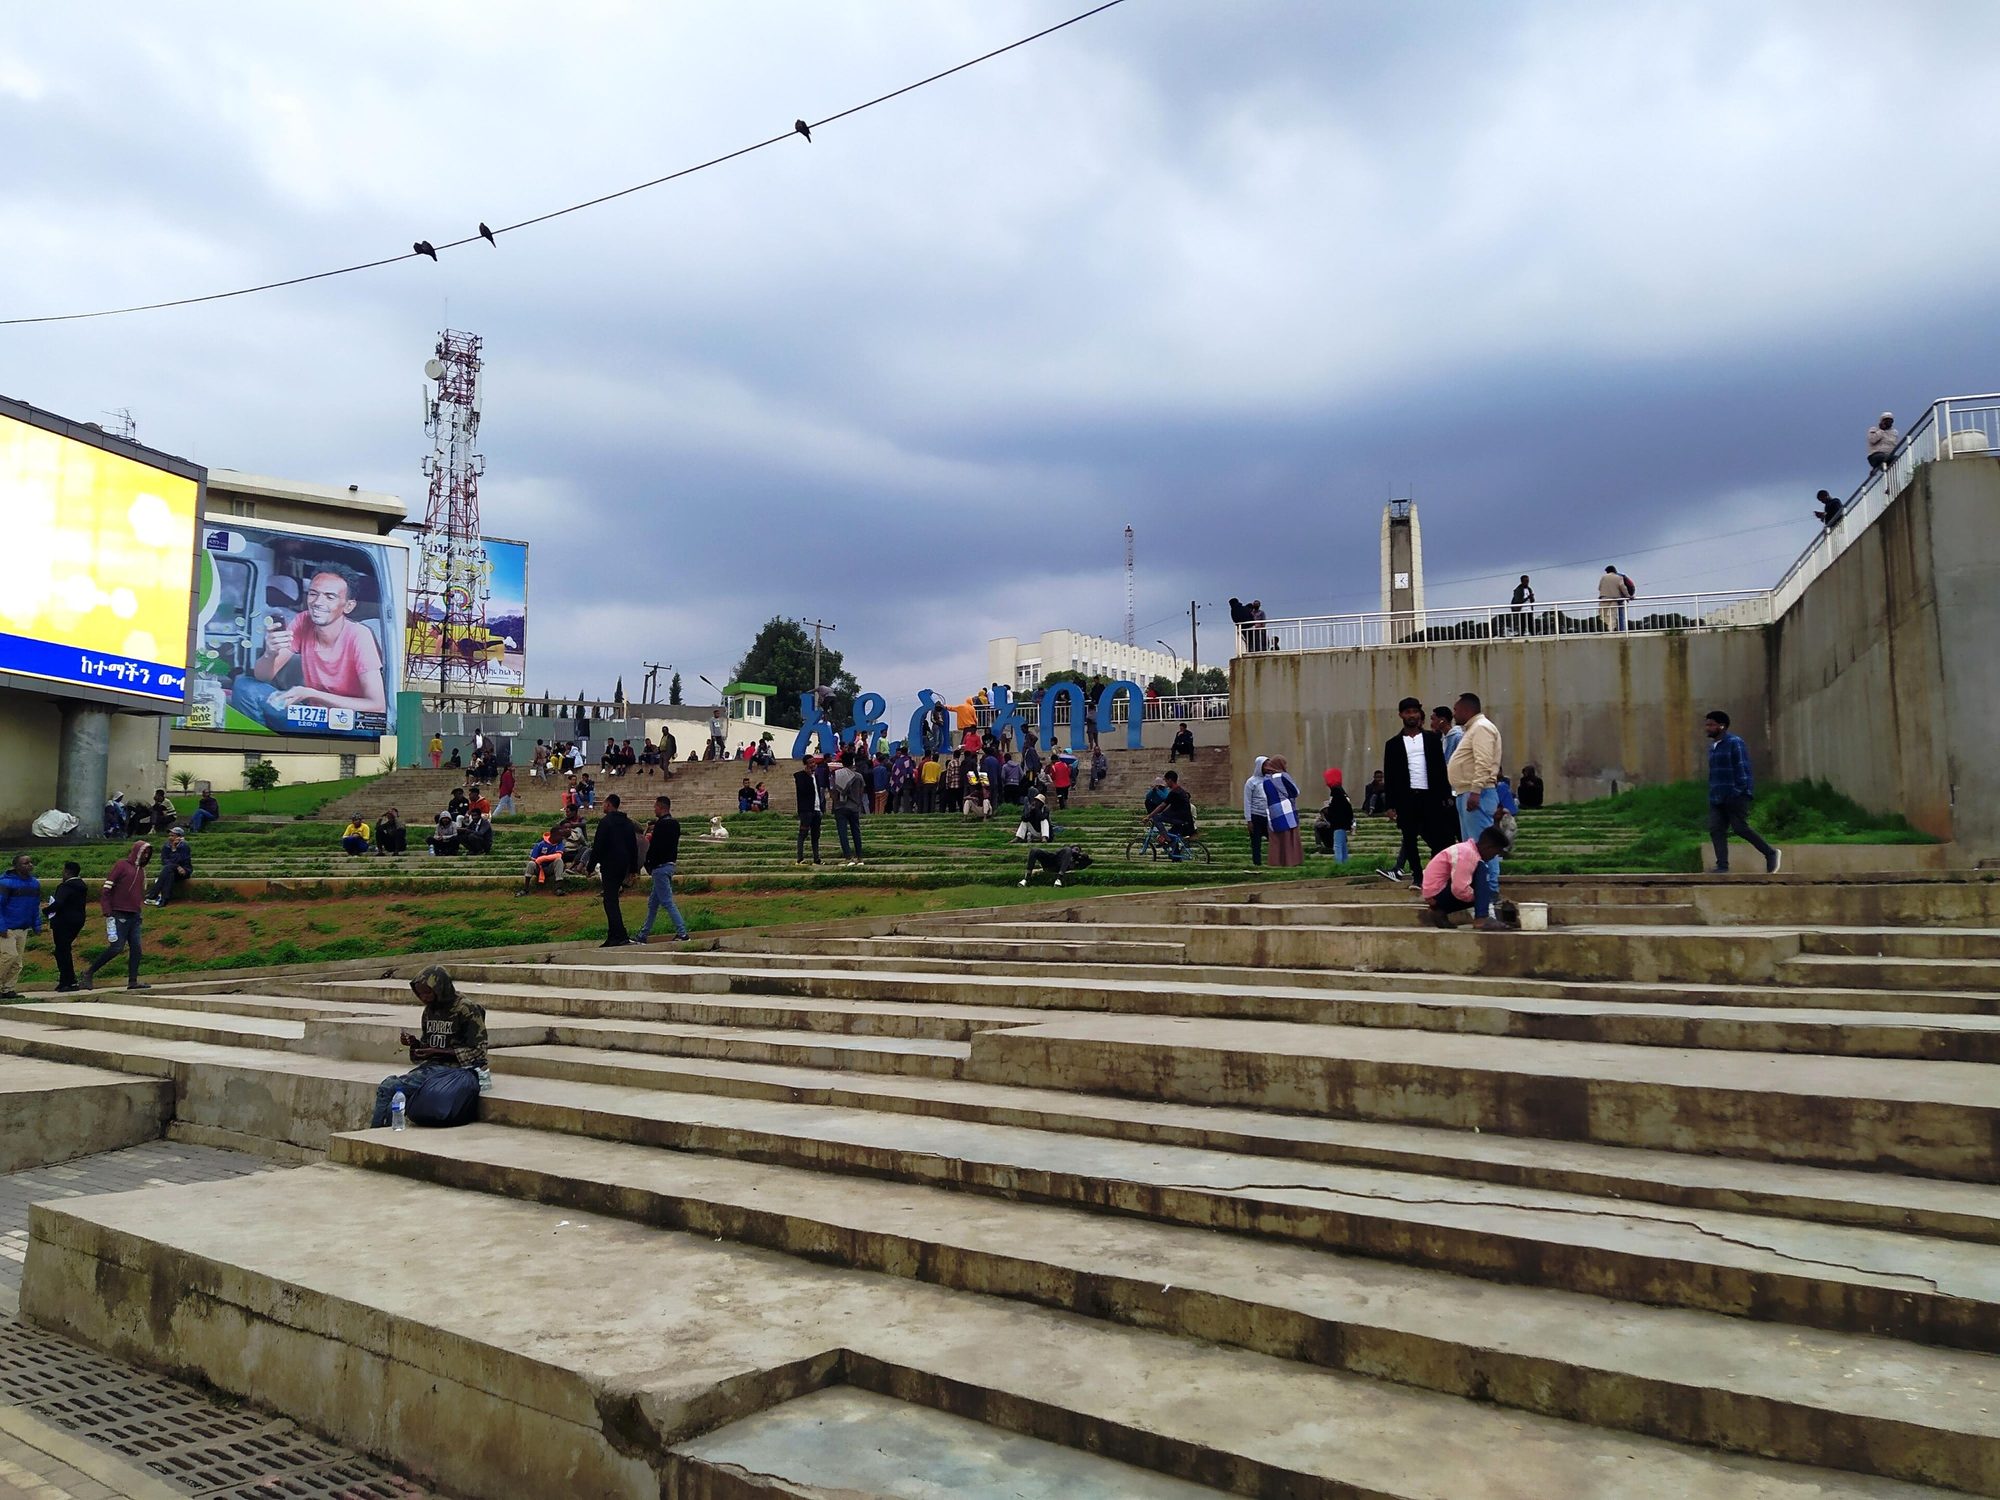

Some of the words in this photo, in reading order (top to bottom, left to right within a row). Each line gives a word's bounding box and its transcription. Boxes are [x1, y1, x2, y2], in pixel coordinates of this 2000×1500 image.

[81, 655, 150, 685] ከተማችን
[792, 688, 953, 760] አዲስ
[991, 680, 1144, 752] አበባ
